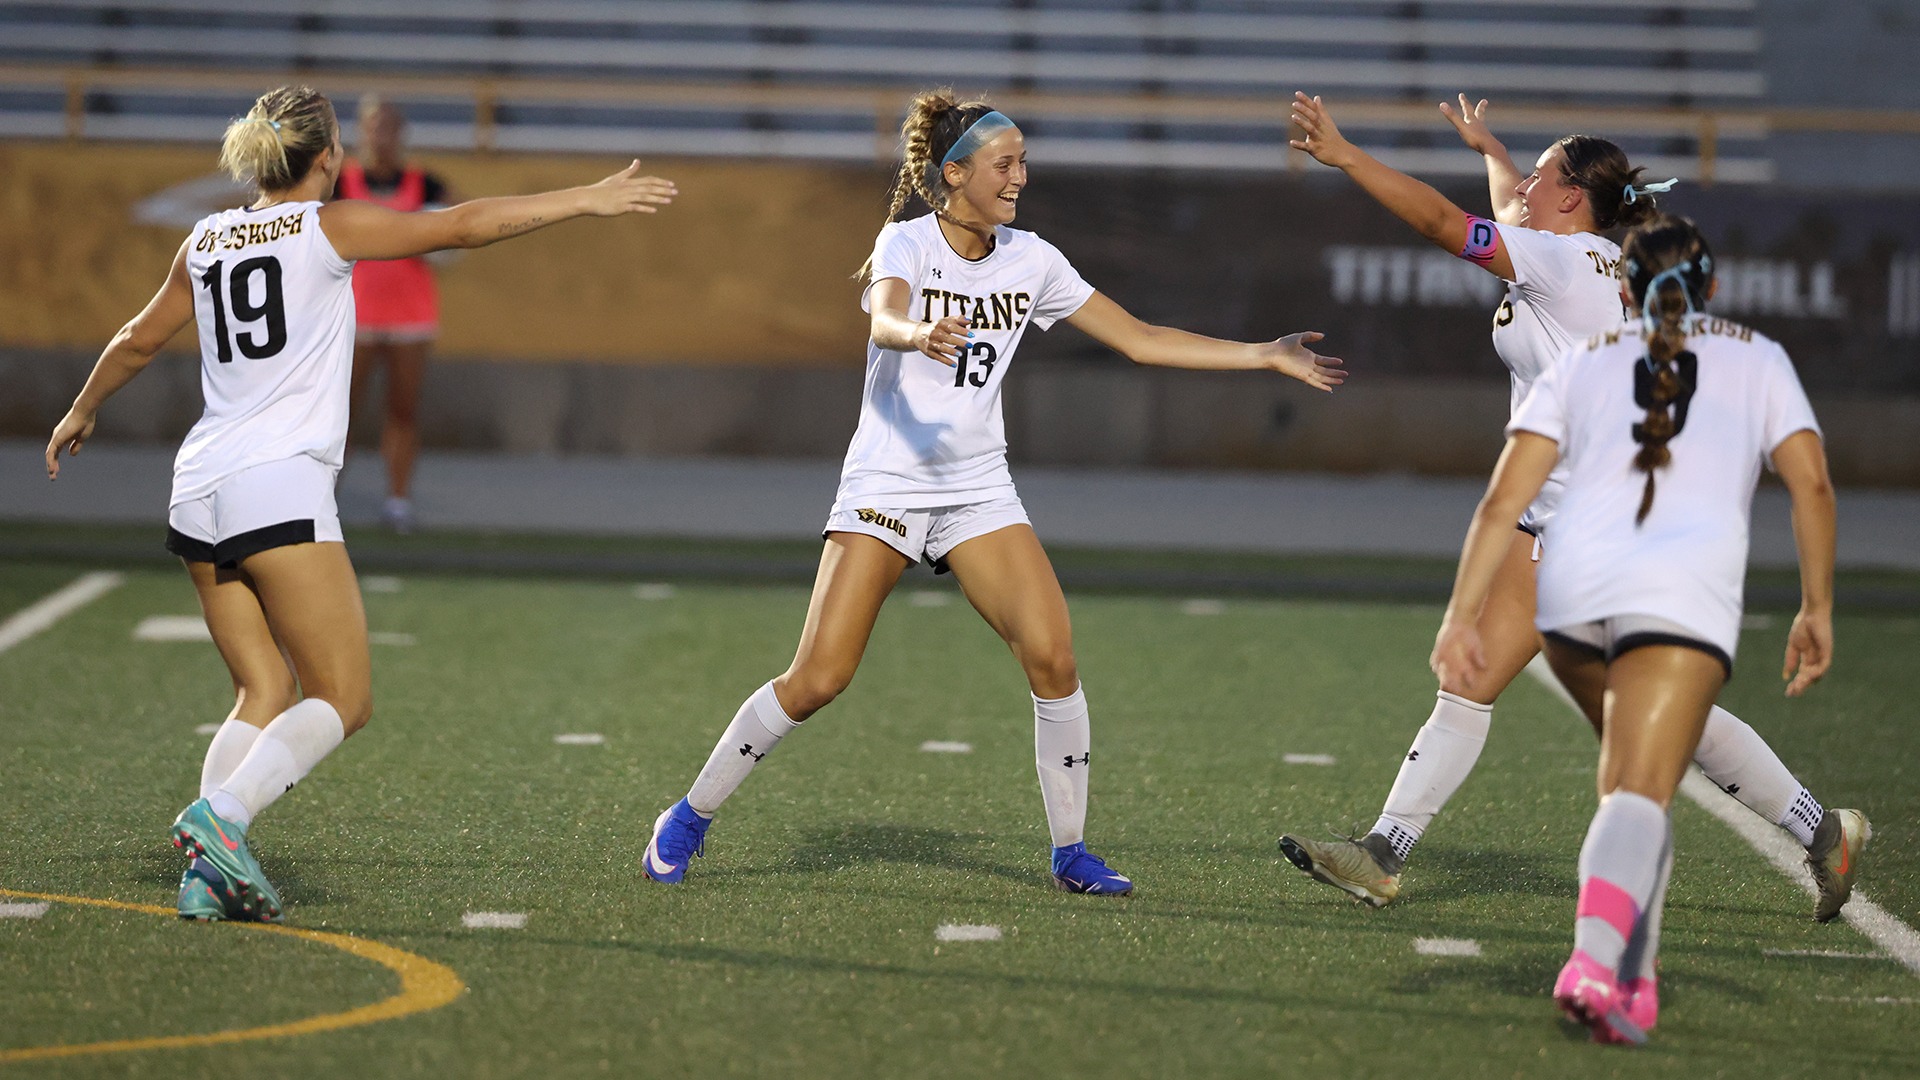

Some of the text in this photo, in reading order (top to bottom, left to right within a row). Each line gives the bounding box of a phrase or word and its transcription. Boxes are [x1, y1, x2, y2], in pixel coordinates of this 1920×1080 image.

[1474, 223, 1491, 247] C
[201, 255, 287, 363] 19
[921, 288, 1030, 331] TITANS
[954, 342, 997, 388] 13
